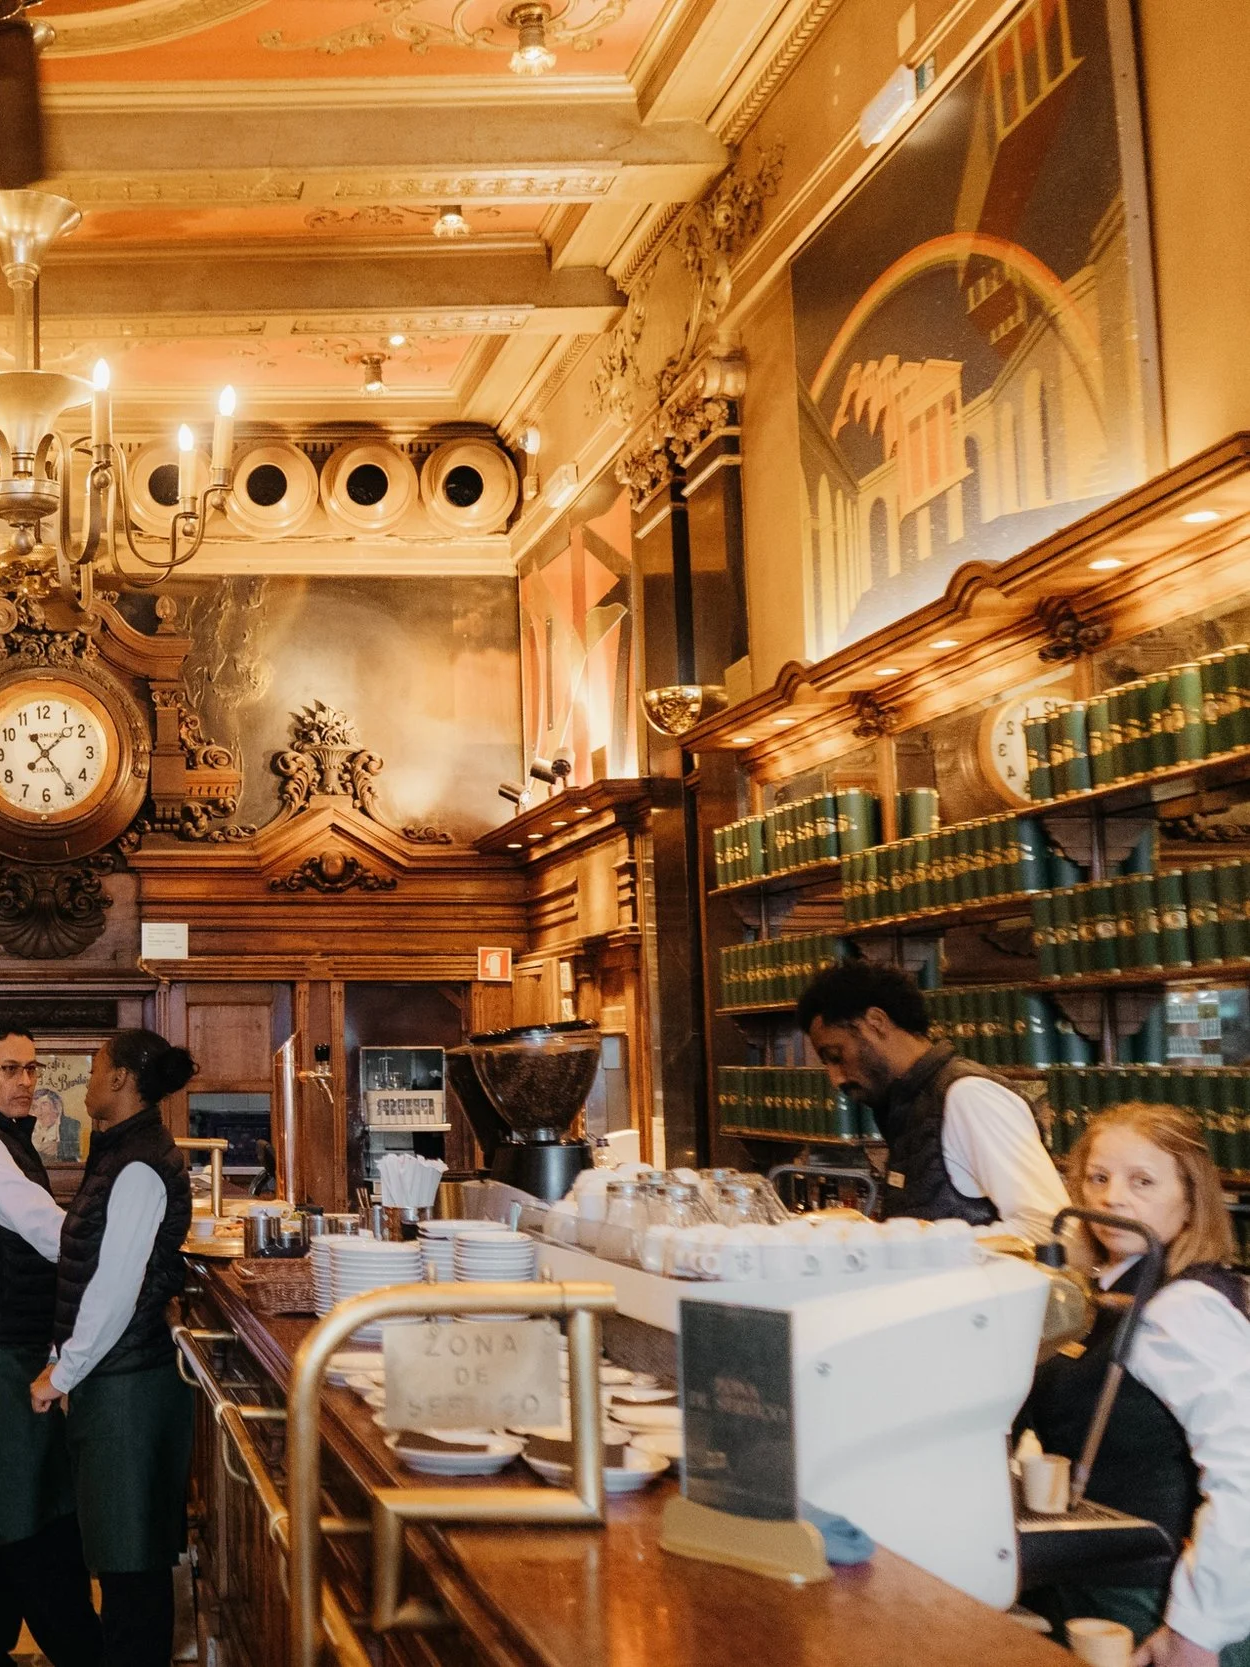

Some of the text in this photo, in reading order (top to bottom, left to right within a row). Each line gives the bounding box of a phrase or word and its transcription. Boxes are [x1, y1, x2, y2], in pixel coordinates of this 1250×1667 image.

[18, 712, 28, 726] 11
[37, 705, 50, 719] 12
[62, 710, 68, 724] 1
[2, 728, 16, 742] 10
[77, 724, 86, 738] 2
[85, 746, 94, 760] 3
[4, 769, 14, 784] 8
[78, 768, 87, 782] 4
[21, 784, 30, 798] 7
[42, 788, 51, 802] 6
[64, 783, 74, 797] 5
[424, 1334, 518, 1357] ZONA
[454, 1366, 489, 1386] DE
